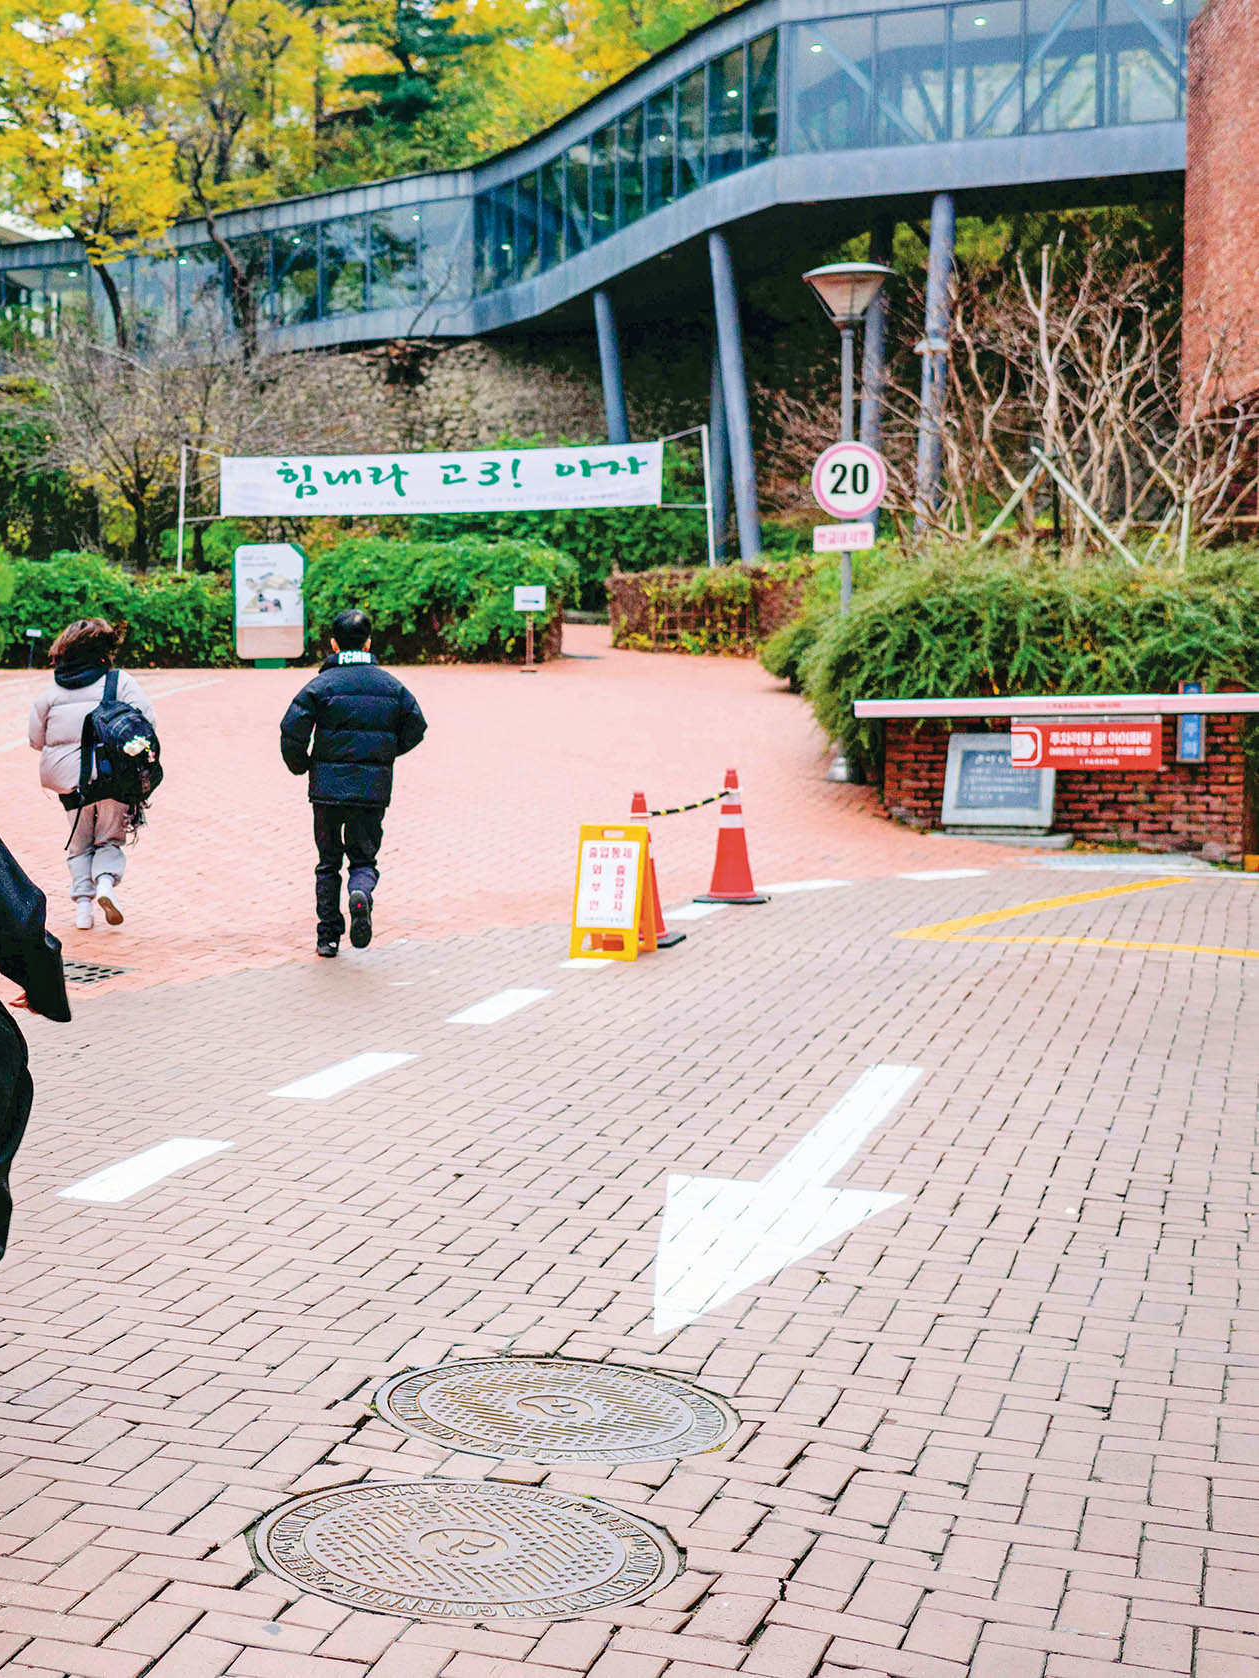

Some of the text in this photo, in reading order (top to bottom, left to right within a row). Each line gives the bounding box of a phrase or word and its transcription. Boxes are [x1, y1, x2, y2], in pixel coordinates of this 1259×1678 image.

[276, 456, 648, 499] 힘내라 고3! 아자
[830, 463, 869, 494] 20
[338, 651, 372, 664] FCMM
[435, 1483, 575, 1509] GOVERNMENT
[340, 1585, 496, 1617] GOVERNMENT
